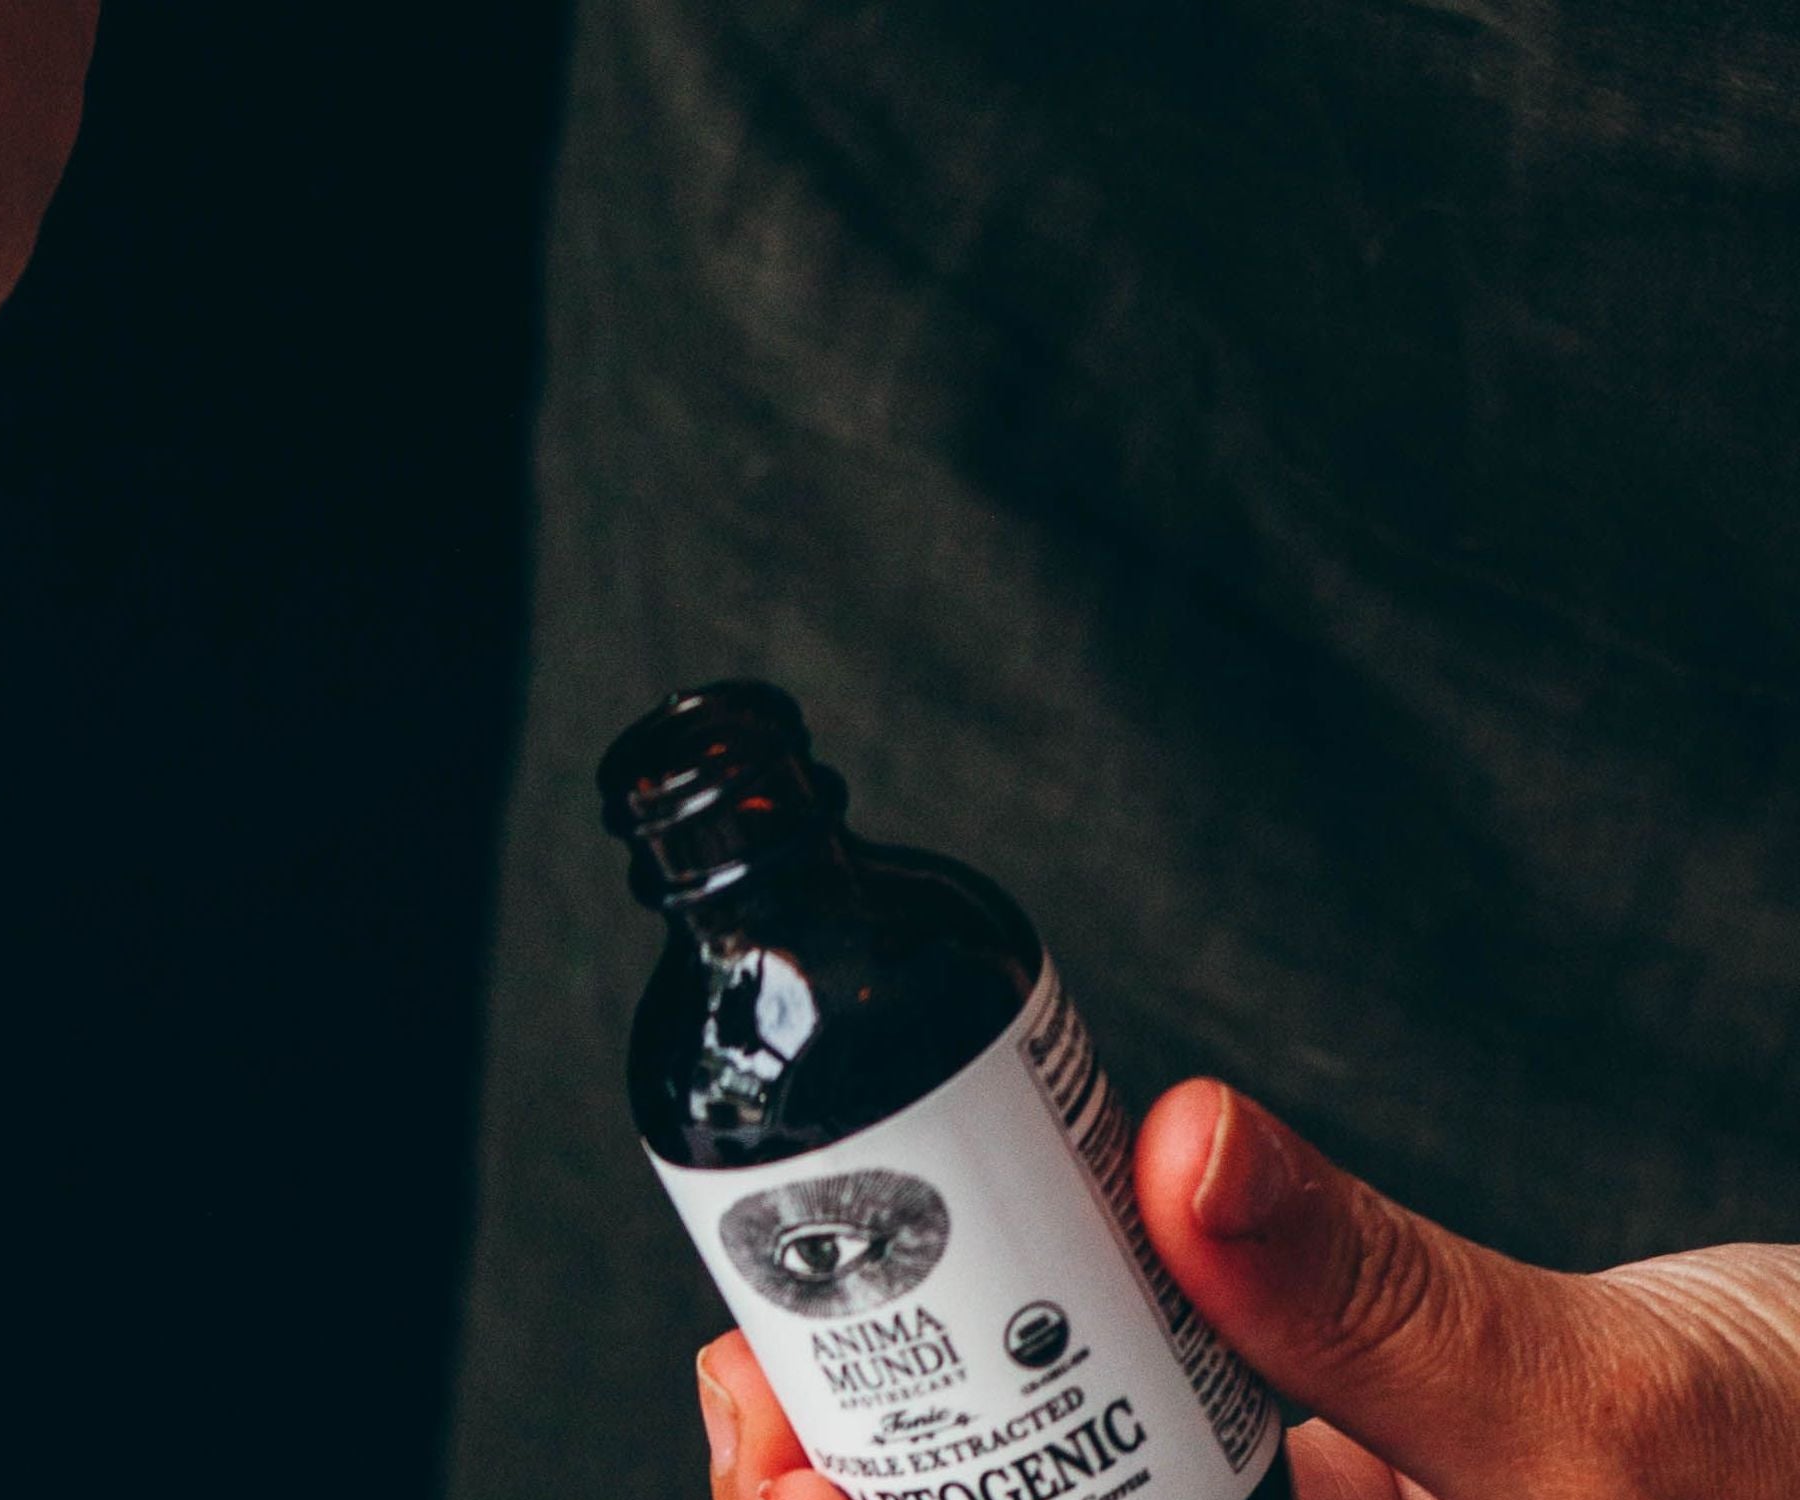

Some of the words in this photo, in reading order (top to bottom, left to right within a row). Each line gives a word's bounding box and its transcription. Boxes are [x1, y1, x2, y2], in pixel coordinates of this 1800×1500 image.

[812, 1304, 944, 1359] ANIMA
[821, 1335, 960, 1394] MUNDI
[910, 1386, 1085, 1473] EXTRACTED
